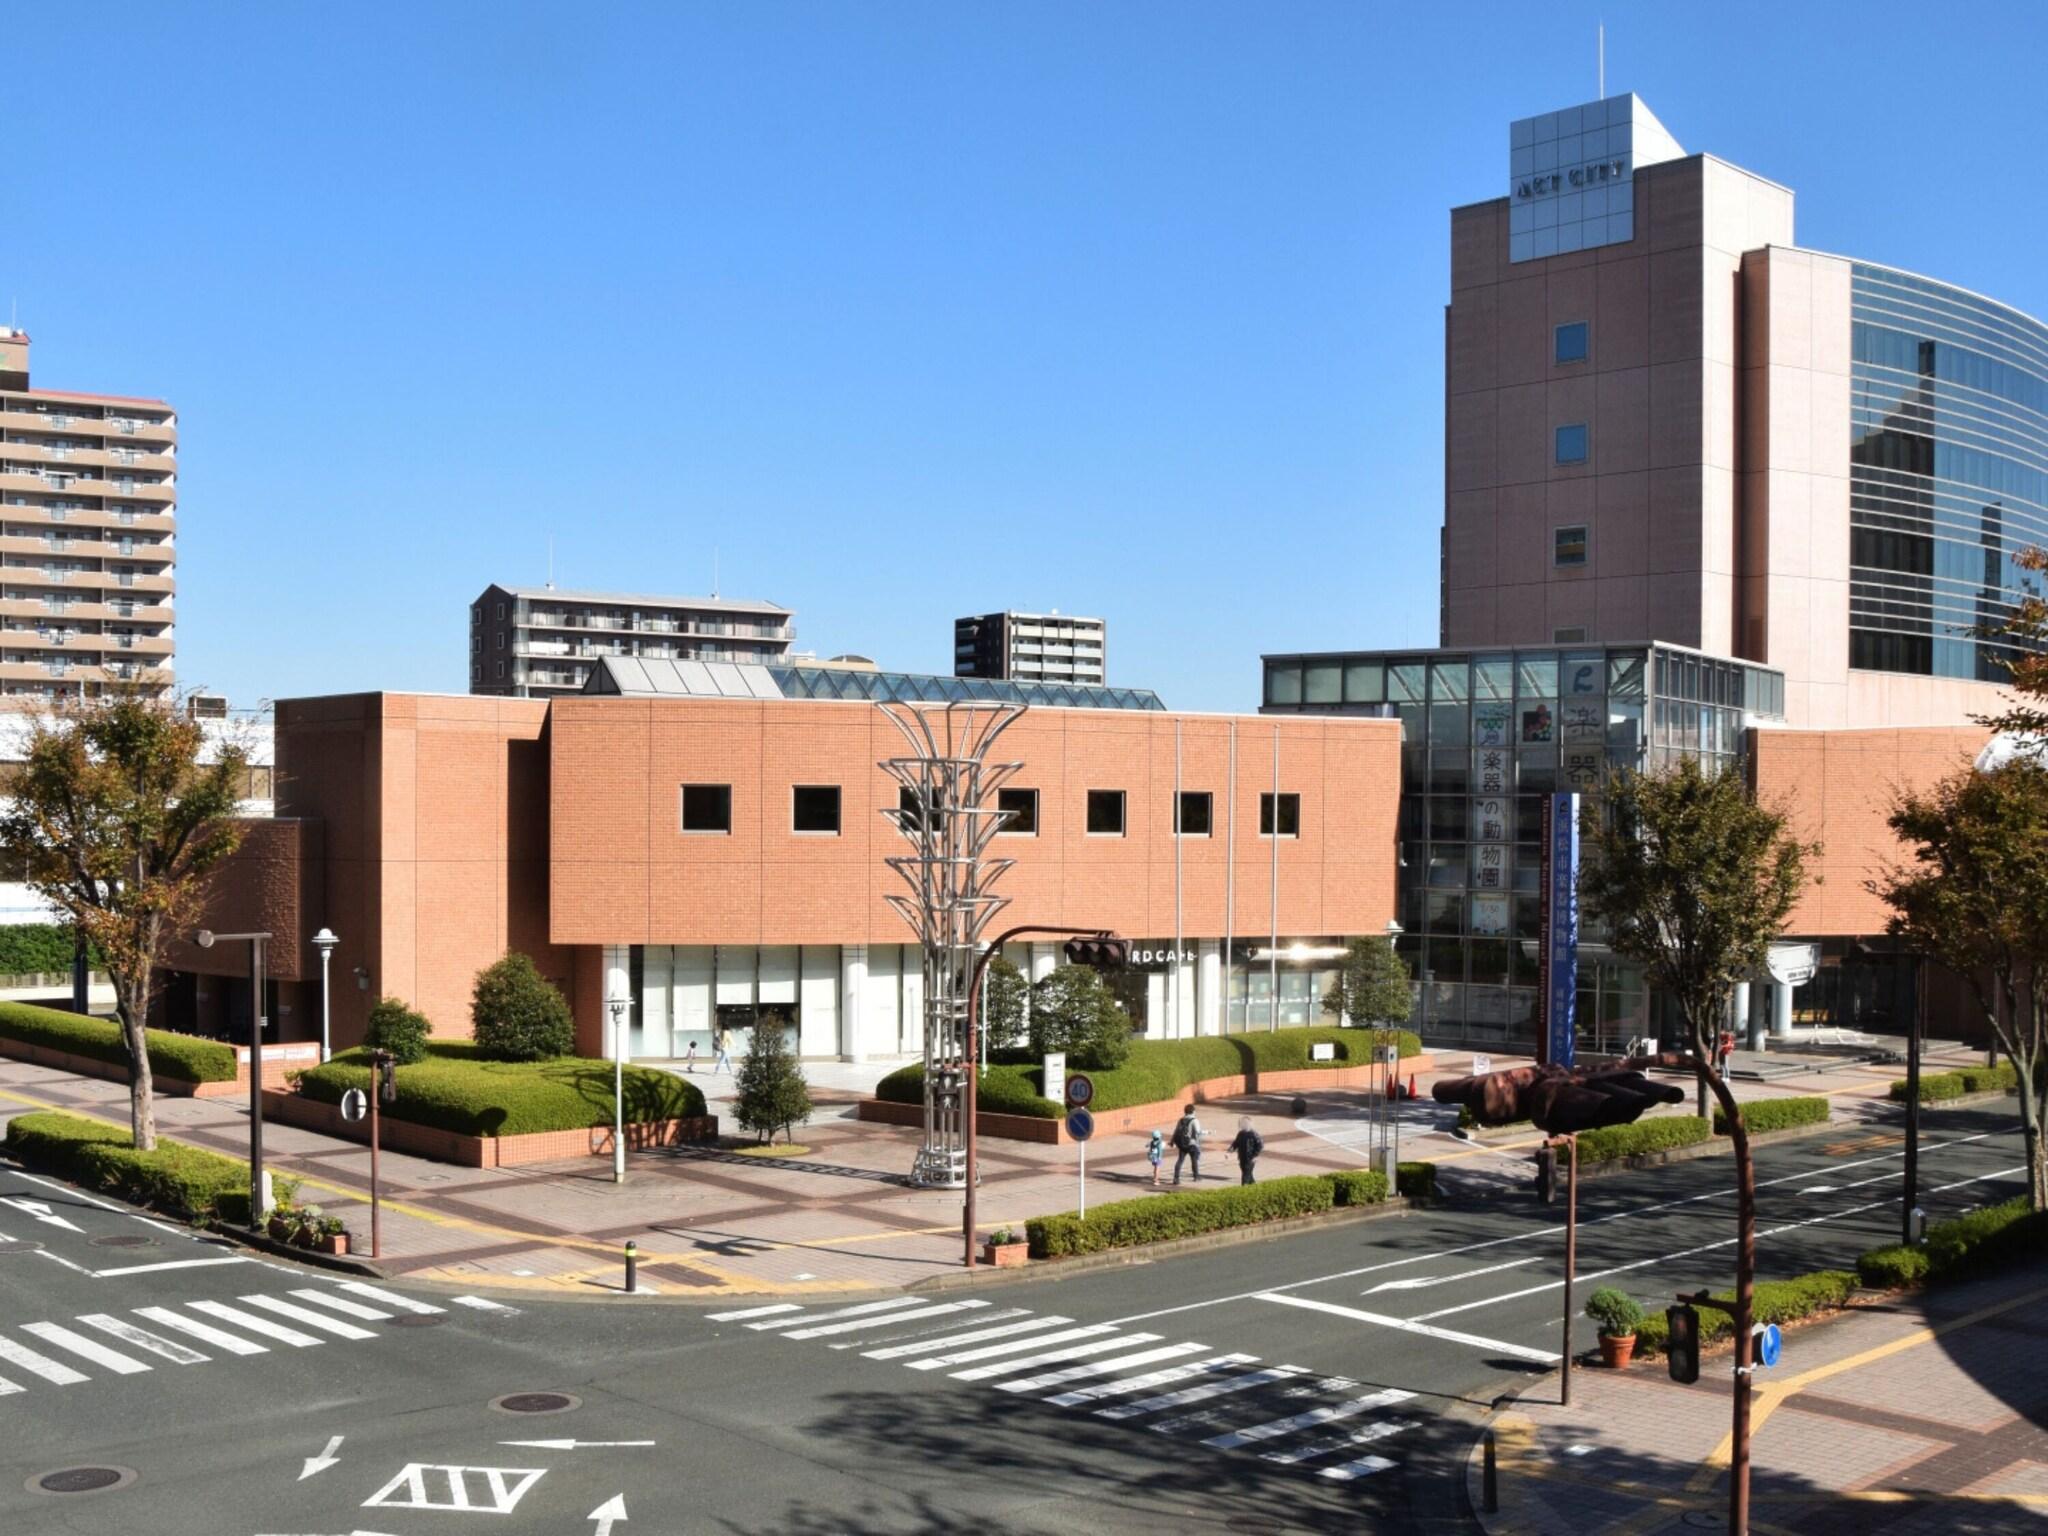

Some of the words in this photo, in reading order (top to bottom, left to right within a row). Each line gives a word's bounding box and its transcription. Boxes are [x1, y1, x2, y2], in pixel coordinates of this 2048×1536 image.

[1518, 175, 1561, 198] ACT
[1568, 160, 1625, 187] CITY
[1482, 751, 1501, 888] 楽器の動物園
[1072, 1083, 1087, 1098] 40
